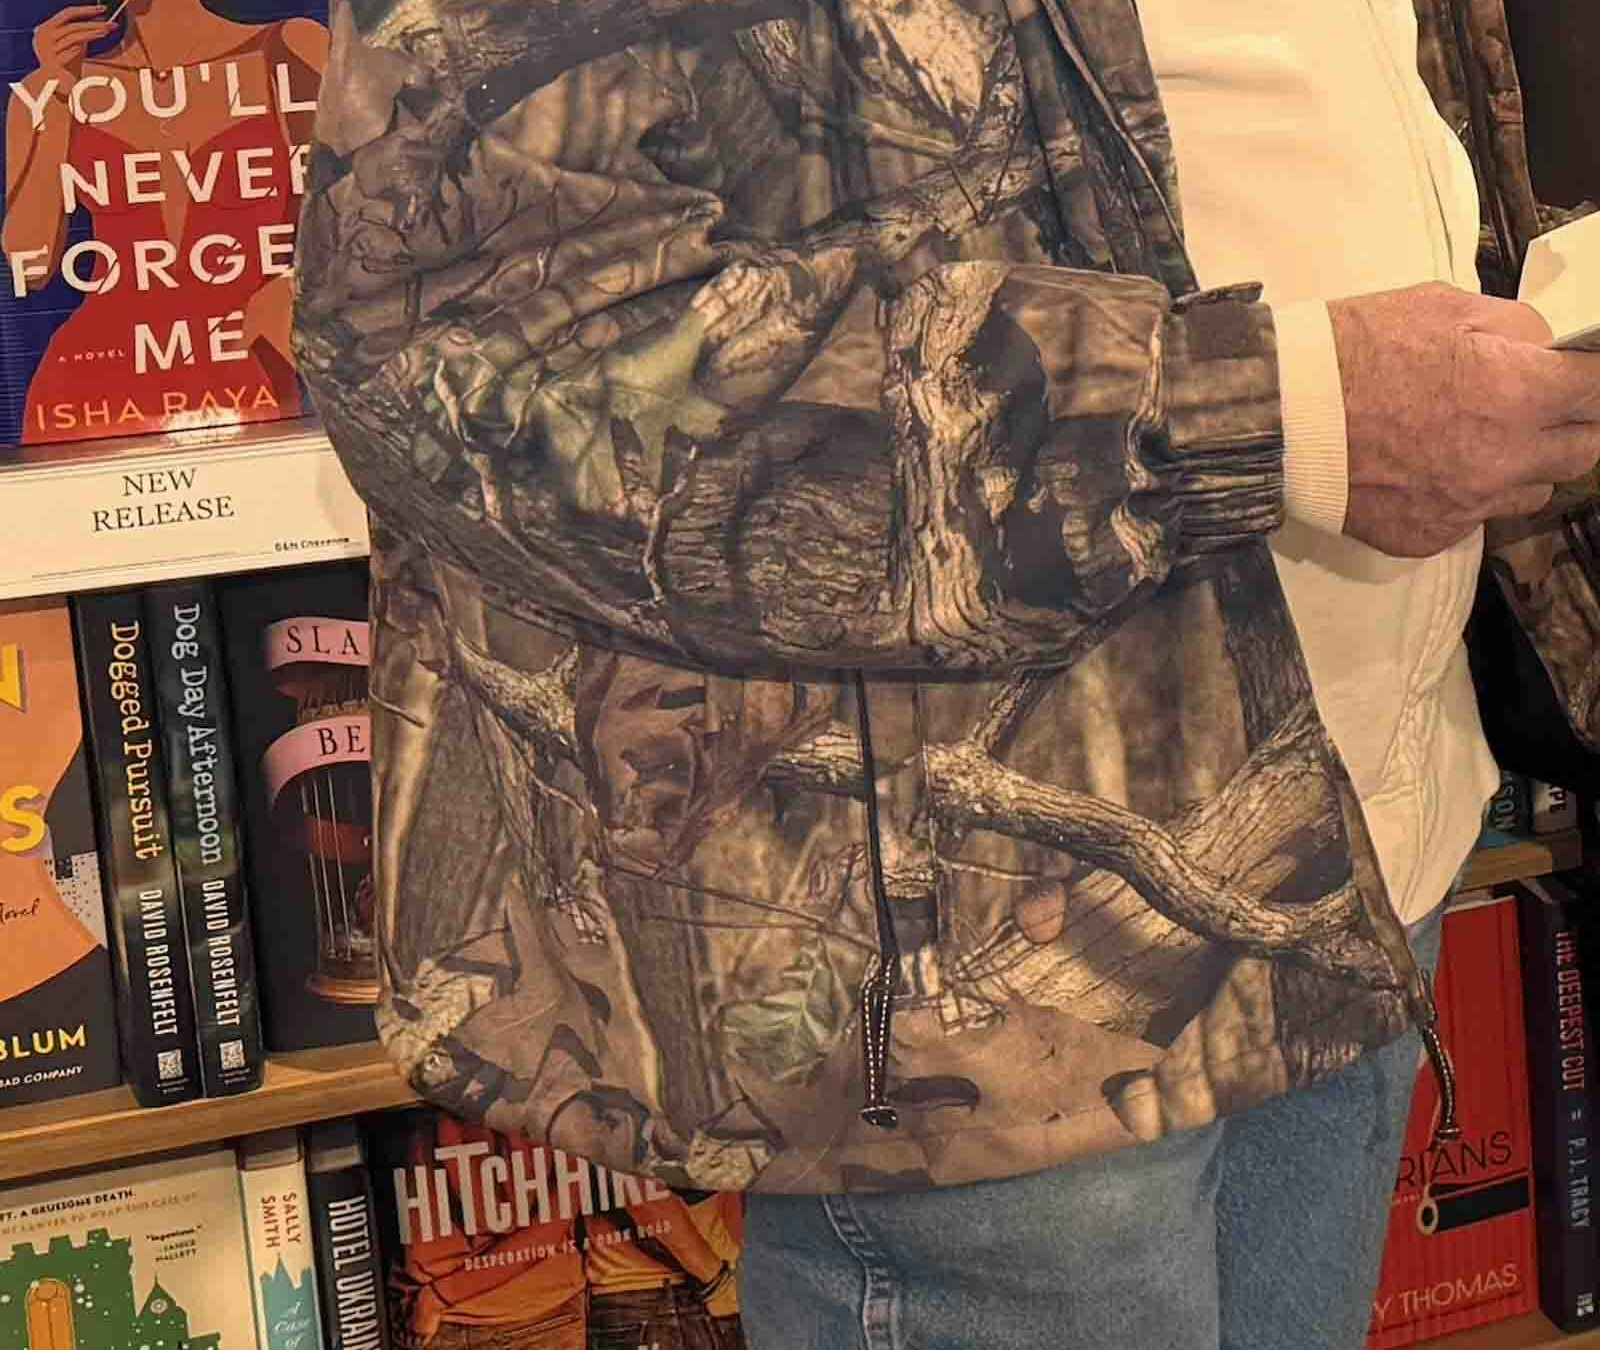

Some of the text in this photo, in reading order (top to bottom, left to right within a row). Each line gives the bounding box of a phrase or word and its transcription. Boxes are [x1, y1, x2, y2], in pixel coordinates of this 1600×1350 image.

[9, 62, 317, 131] YOU'LL
[10, 223, 296, 298] FORGE
[75, 348, 126, 362] NOVEL
[134, 310, 249, 375] ME
[36, 384, 279, 431] ISHA RAYA
[122, 467, 197, 498] NEW
[92, 495, 236, 533] RELEASE
[108, 619, 162, 861] Dogged Pursuit
[171, 603, 223, 867] Dog Day Afternoon
[139, 889, 178, 1036] DAVID ROSENFELT
[200, 877, 241, 1027] DAVID ROSENFELT
[1557, 968, 1585, 1091] DEEPEST CUT
[24, 1064, 84, 1086] COMPANY
[32, 1188, 135, 1216] GRUESOME DEATH.
[260, 1194, 280, 1249] SMITH
[281, 1192, 302, 1244] SALLY
[1569, 1175, 1592, 1229] TRACY
[327, 1195, 369, 1272] HOTEL
[464, 1243, 558, 1273] DESPERATION
[1398, 1263, 1520, 1318] THOMAS
